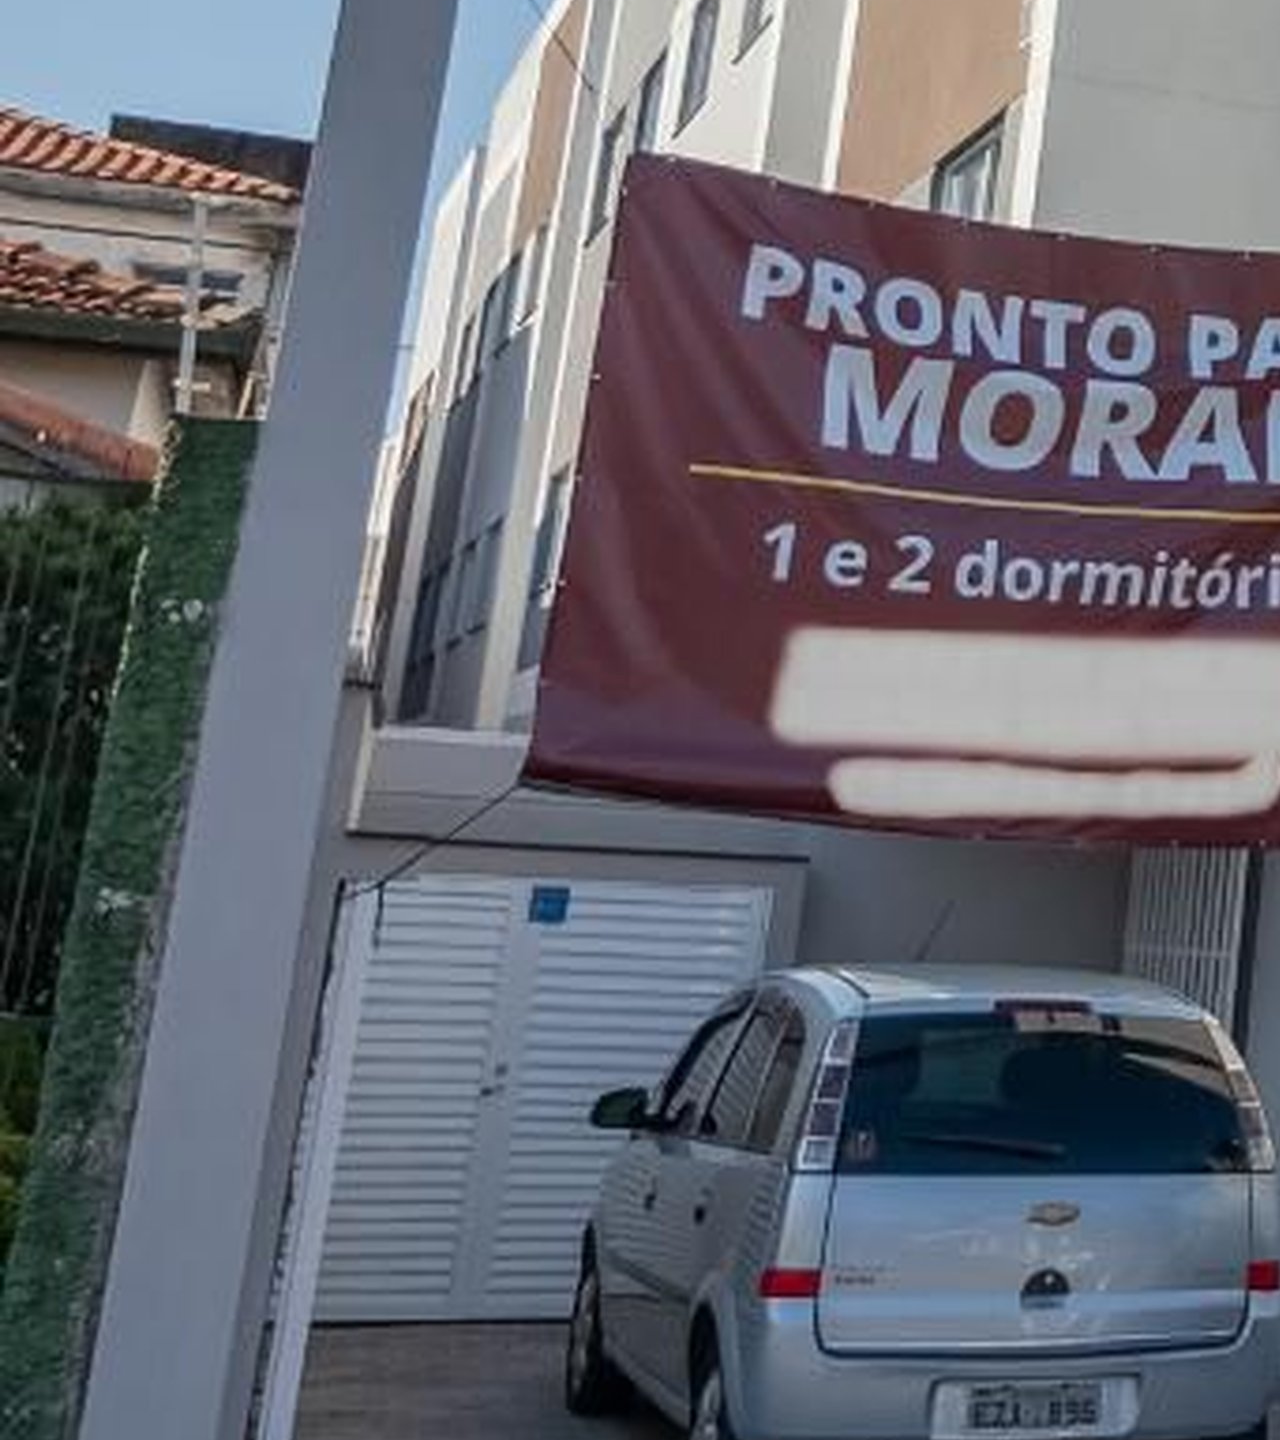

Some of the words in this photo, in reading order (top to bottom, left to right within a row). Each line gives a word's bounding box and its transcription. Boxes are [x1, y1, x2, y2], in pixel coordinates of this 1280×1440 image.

[741, 243, 1156, 376] PRONTO
[763, 522, 797, 582] 1
[823, 539, 868, 587] e
[887, 534, 935, 594] 2
